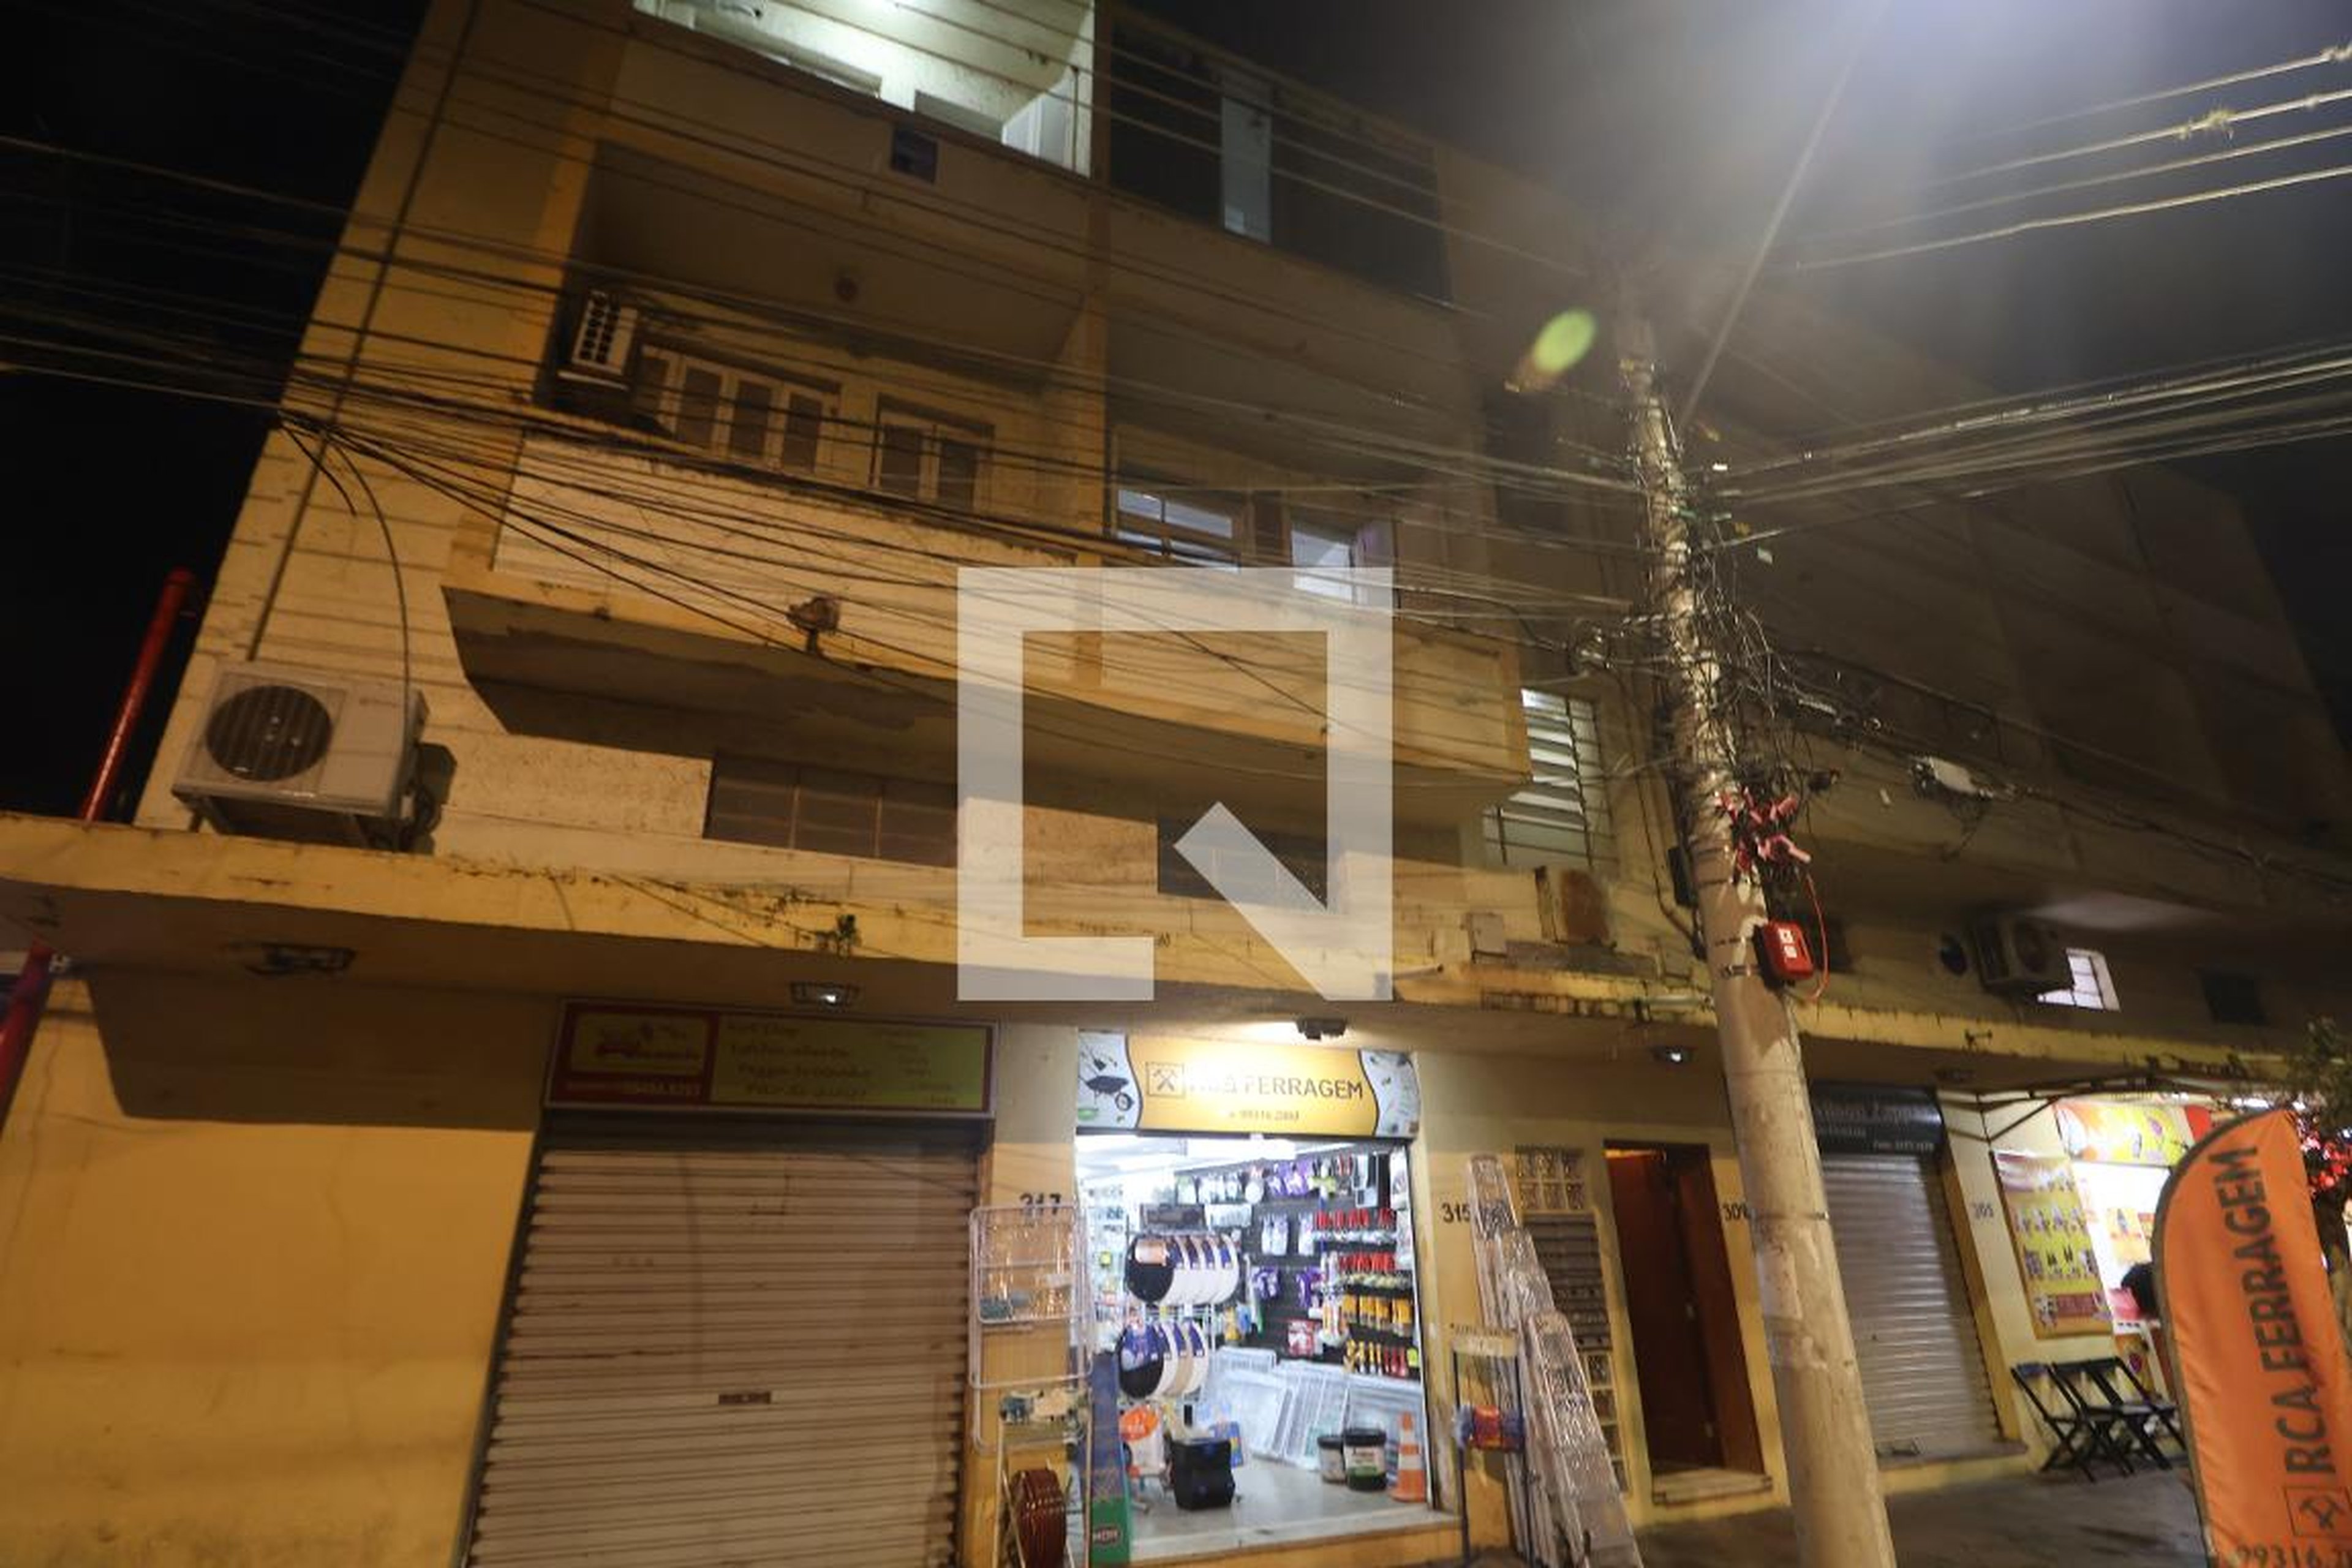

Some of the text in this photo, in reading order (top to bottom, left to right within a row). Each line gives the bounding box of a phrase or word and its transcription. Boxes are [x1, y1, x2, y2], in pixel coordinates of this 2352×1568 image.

[1244, 1076, 1363, 1100] FERRAGEM
[1442, 1202, 1470, 1223] 315
[2208, 1147, 2309, 1373] FERRAGEM
